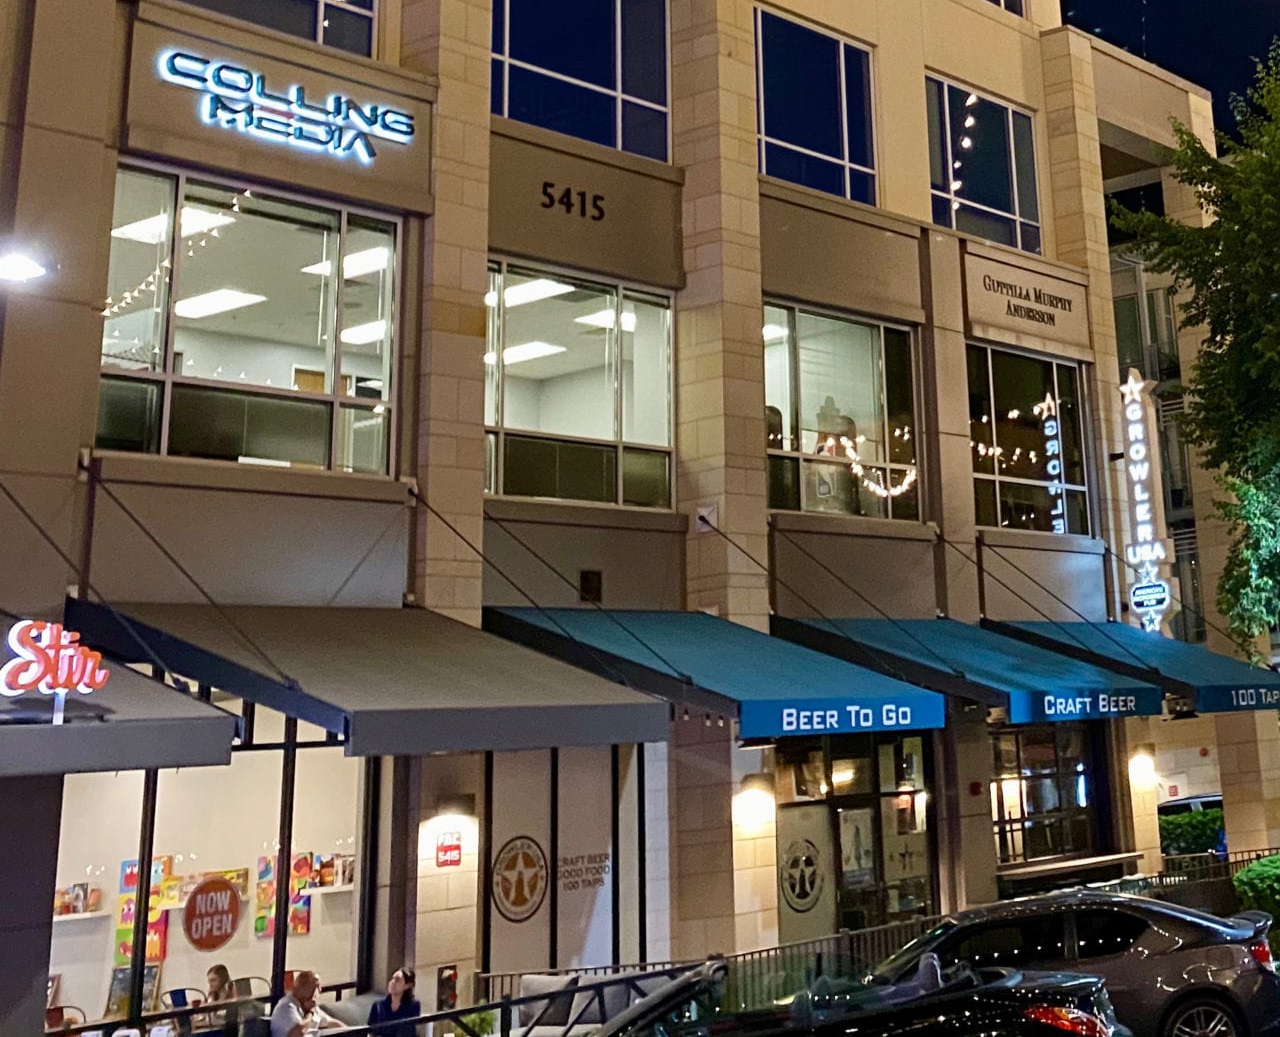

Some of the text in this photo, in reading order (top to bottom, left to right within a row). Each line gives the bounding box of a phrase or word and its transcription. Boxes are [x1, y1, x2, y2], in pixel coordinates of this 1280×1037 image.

[163, 51, 415, 139] COLLING
[206, 94, 376, 160] MEDIA
[541, 181, 605, 221] 5415
[983, 274, 1073, 312] GUTTILLA MURPHY
[1006, 299, 1055, 326] ANDERSON
[1126, 402, 1153, 542] GROWLER
[1127, 542, 1166, 564] USA
[3, 619, 110, 692] Stir
[1044, 694, 1136, 714] CRAFT BEER
[1230, 690, 1256, 706] 100
[782, 704, 911, 731] BEER TO GO
[195, 890, 231, 915] NOW
[191, 913, 233, 939] OPEN
